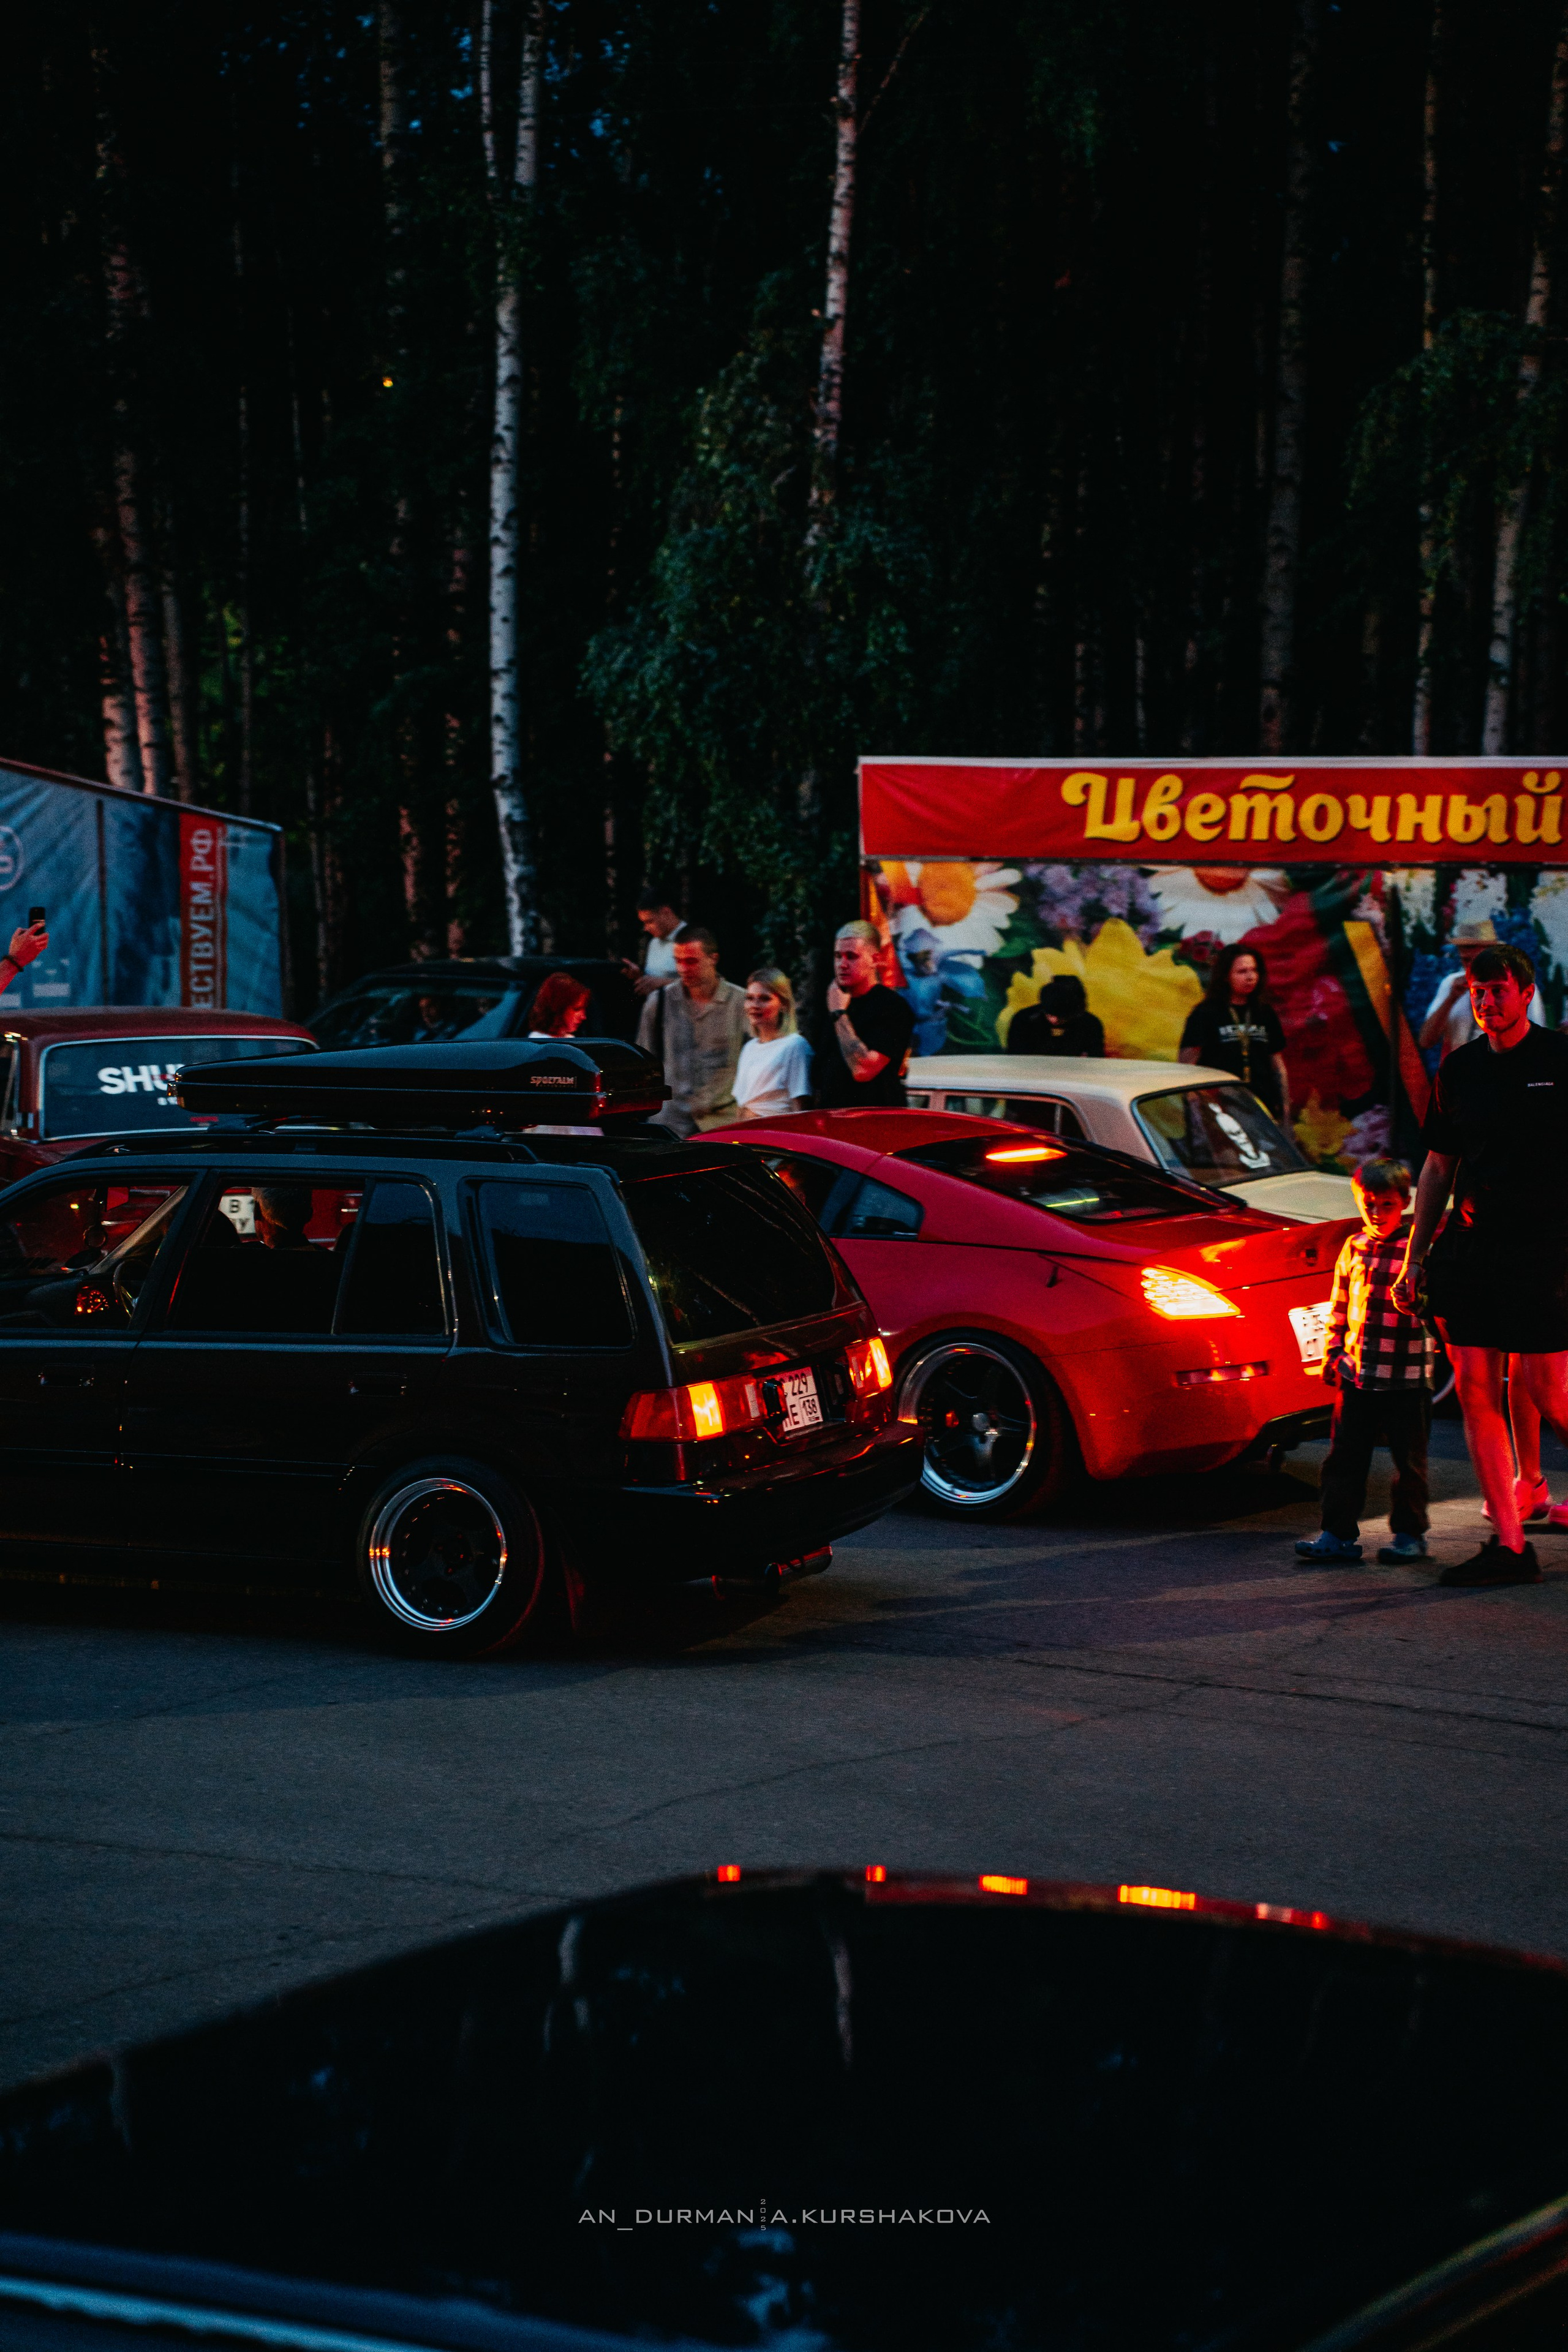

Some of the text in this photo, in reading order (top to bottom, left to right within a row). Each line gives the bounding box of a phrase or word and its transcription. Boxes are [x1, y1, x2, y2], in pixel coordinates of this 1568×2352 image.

[1061, 771, 1564, 844] Цветочный
[97, 1064, 186, 1095] SHU
[780, 1373, 809, 1396] 229
[802, 1398, 818, 1416] 138
